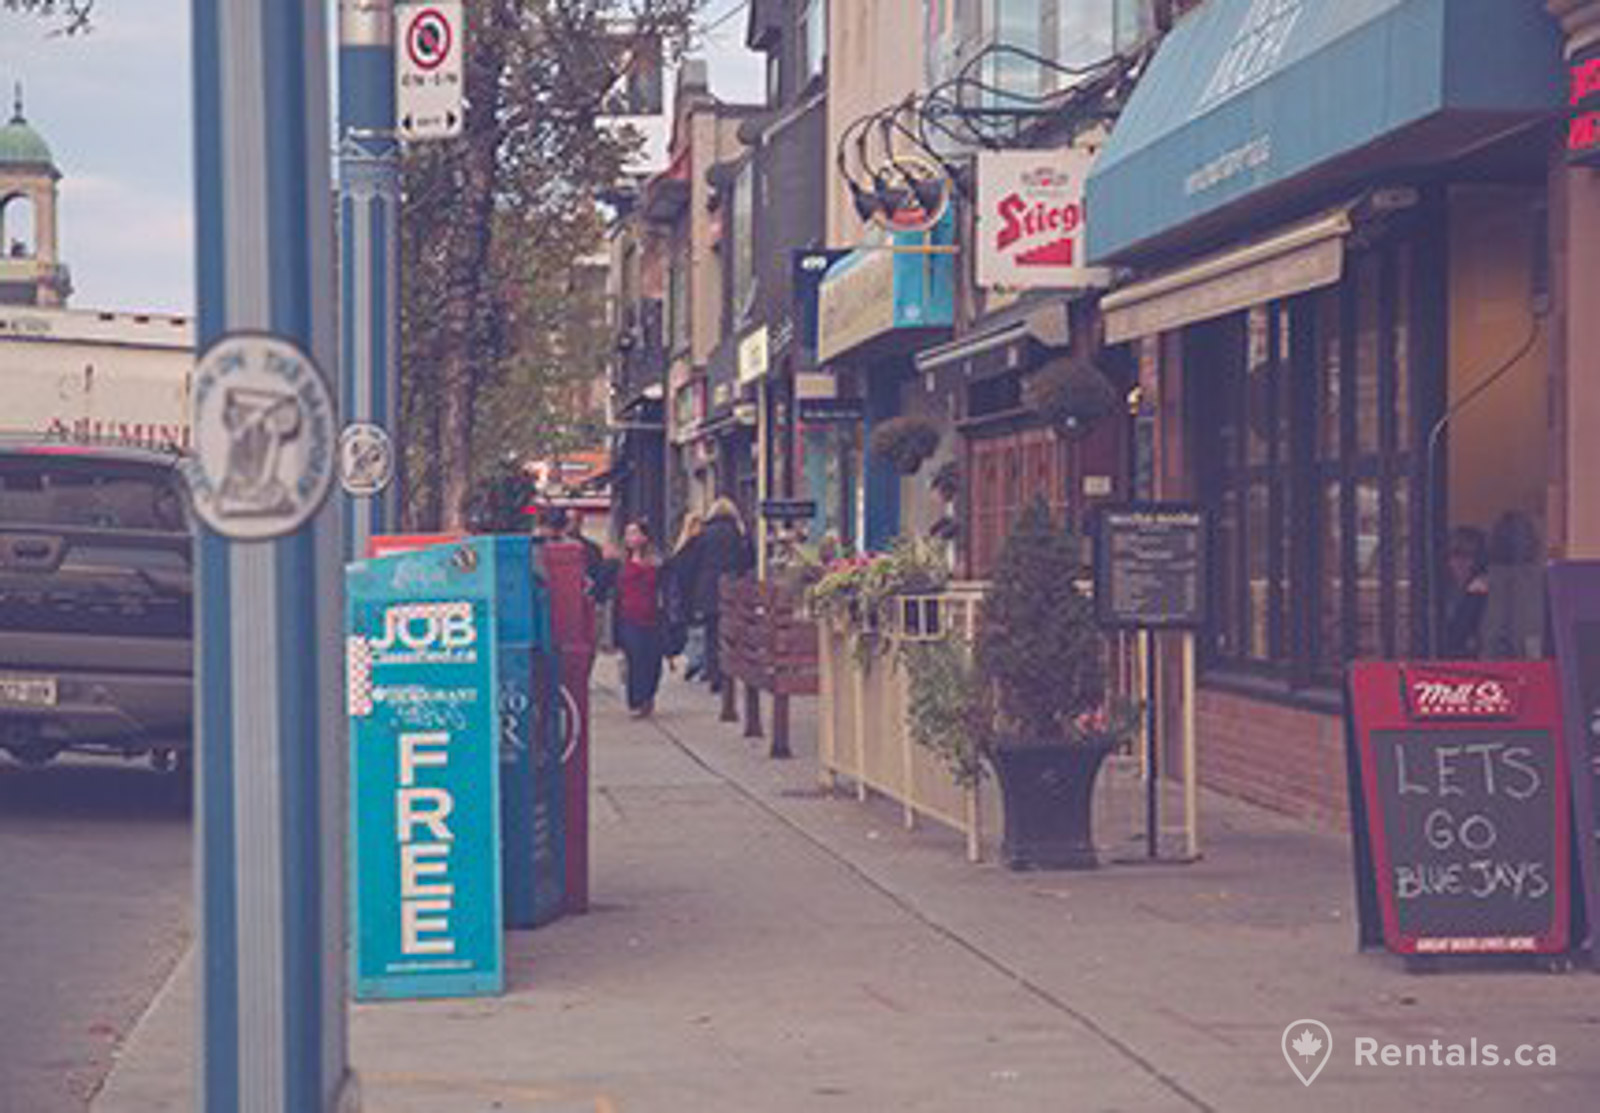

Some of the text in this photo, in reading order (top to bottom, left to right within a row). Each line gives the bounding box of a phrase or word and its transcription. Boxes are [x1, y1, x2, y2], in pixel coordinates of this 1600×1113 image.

[368, 602, 477, 650] JOB
[1395, 743, 1541, 799] LETS
[397, 731, 456, 955] FREE
[1424, 809, 1497, 851] GO
[1396, 860, 1550, 899] BLUE JAYS
